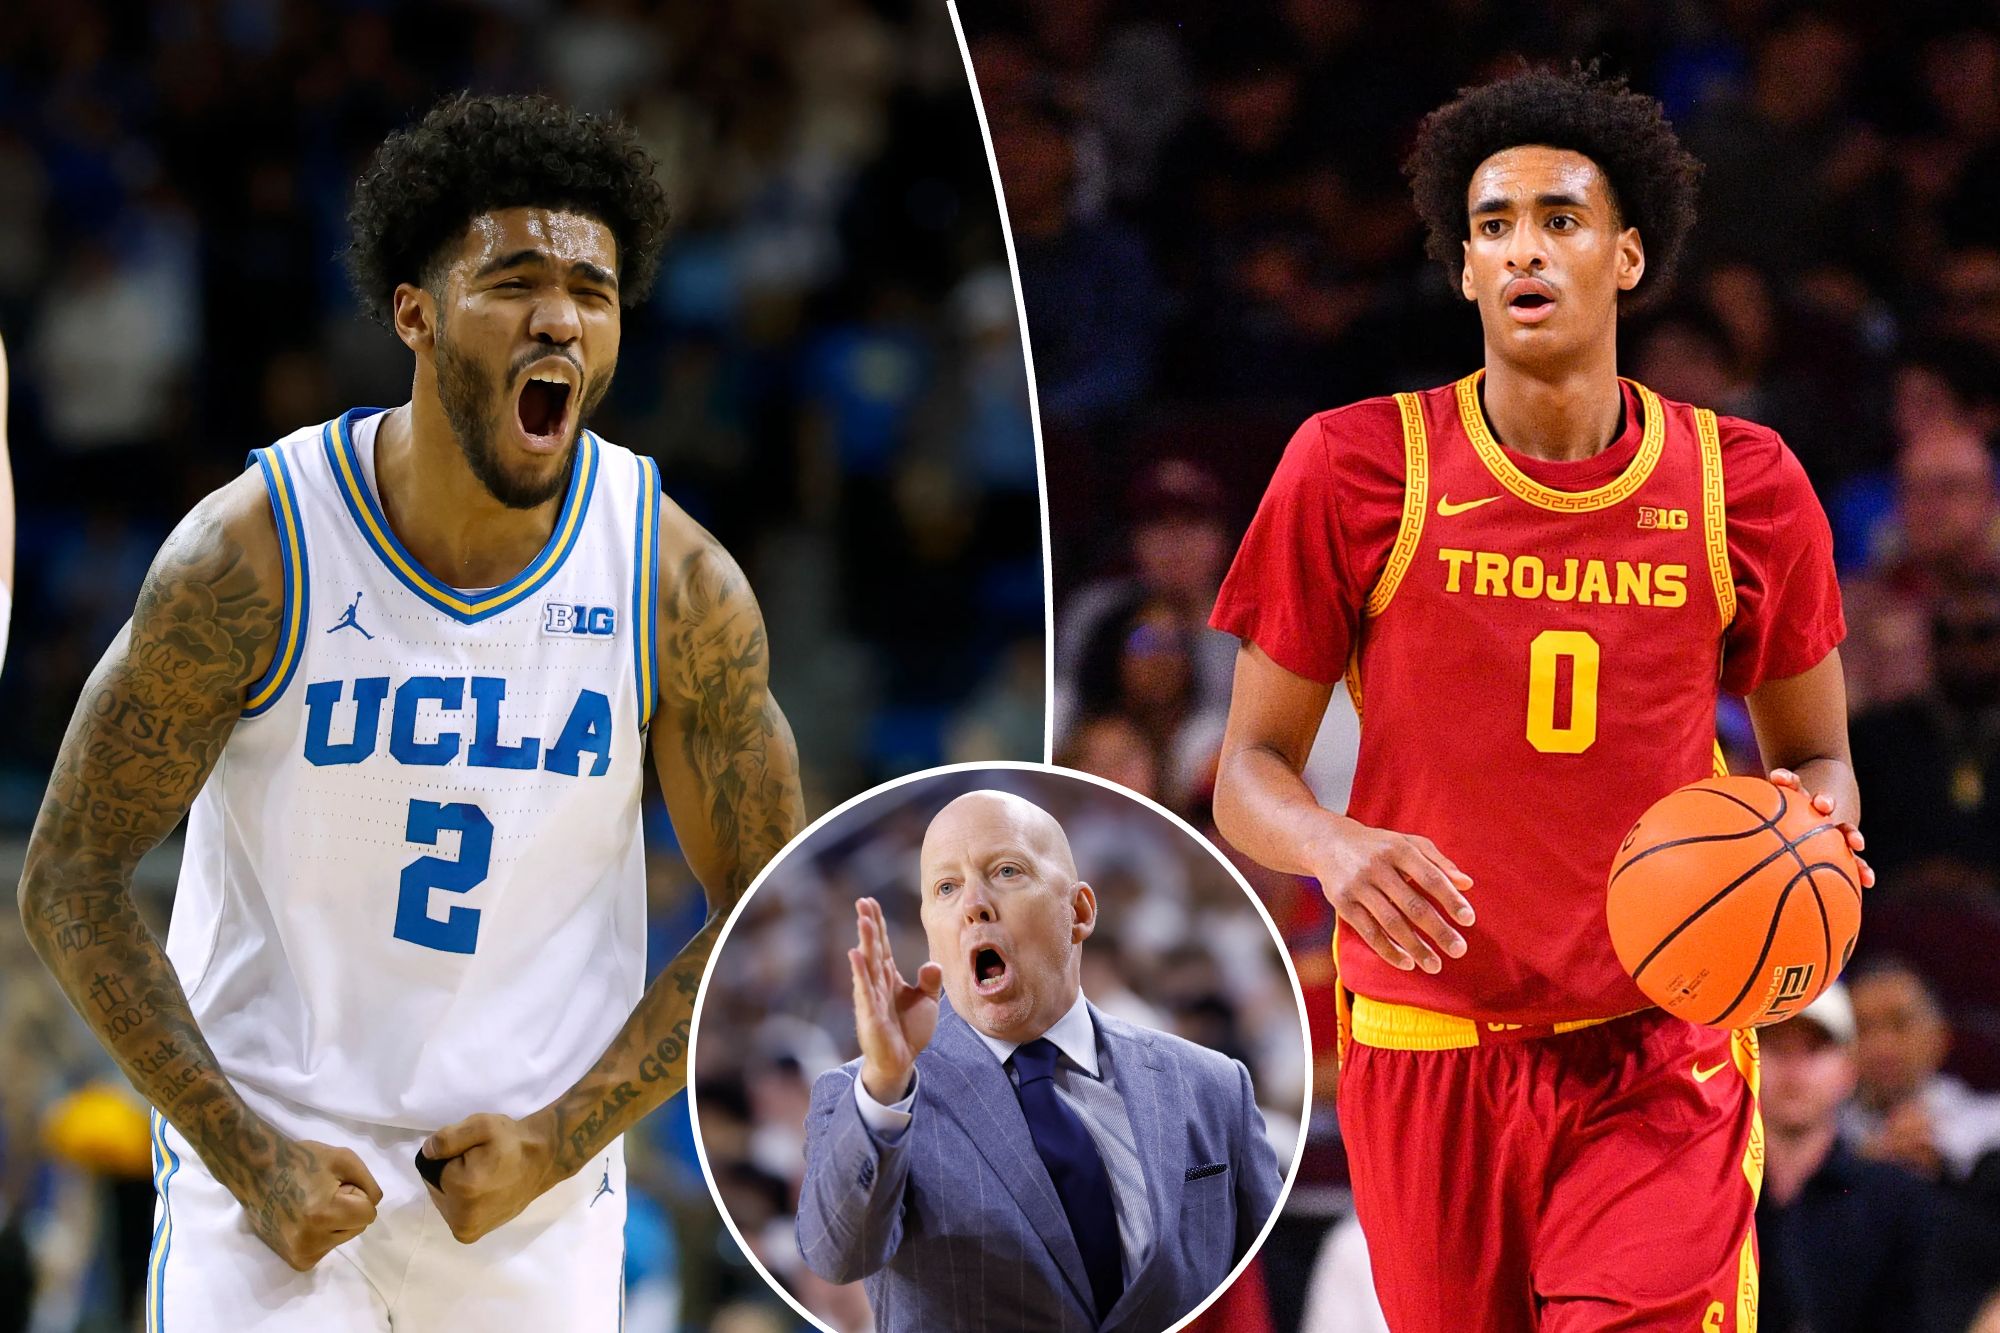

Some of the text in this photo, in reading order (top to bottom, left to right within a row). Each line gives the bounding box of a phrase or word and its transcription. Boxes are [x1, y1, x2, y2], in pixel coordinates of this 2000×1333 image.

[1439, 548, 1688, 608] TROJANS
[94, 689, 176, 748] orst
[304, 677, 613, 777] UCLA
[1526, 630, 1600, 754] 0
[393, 799, 494, 954] 2
[128, 1040, 181, 1079] Risk
[570, 1081, 643, 1160] FEAR
